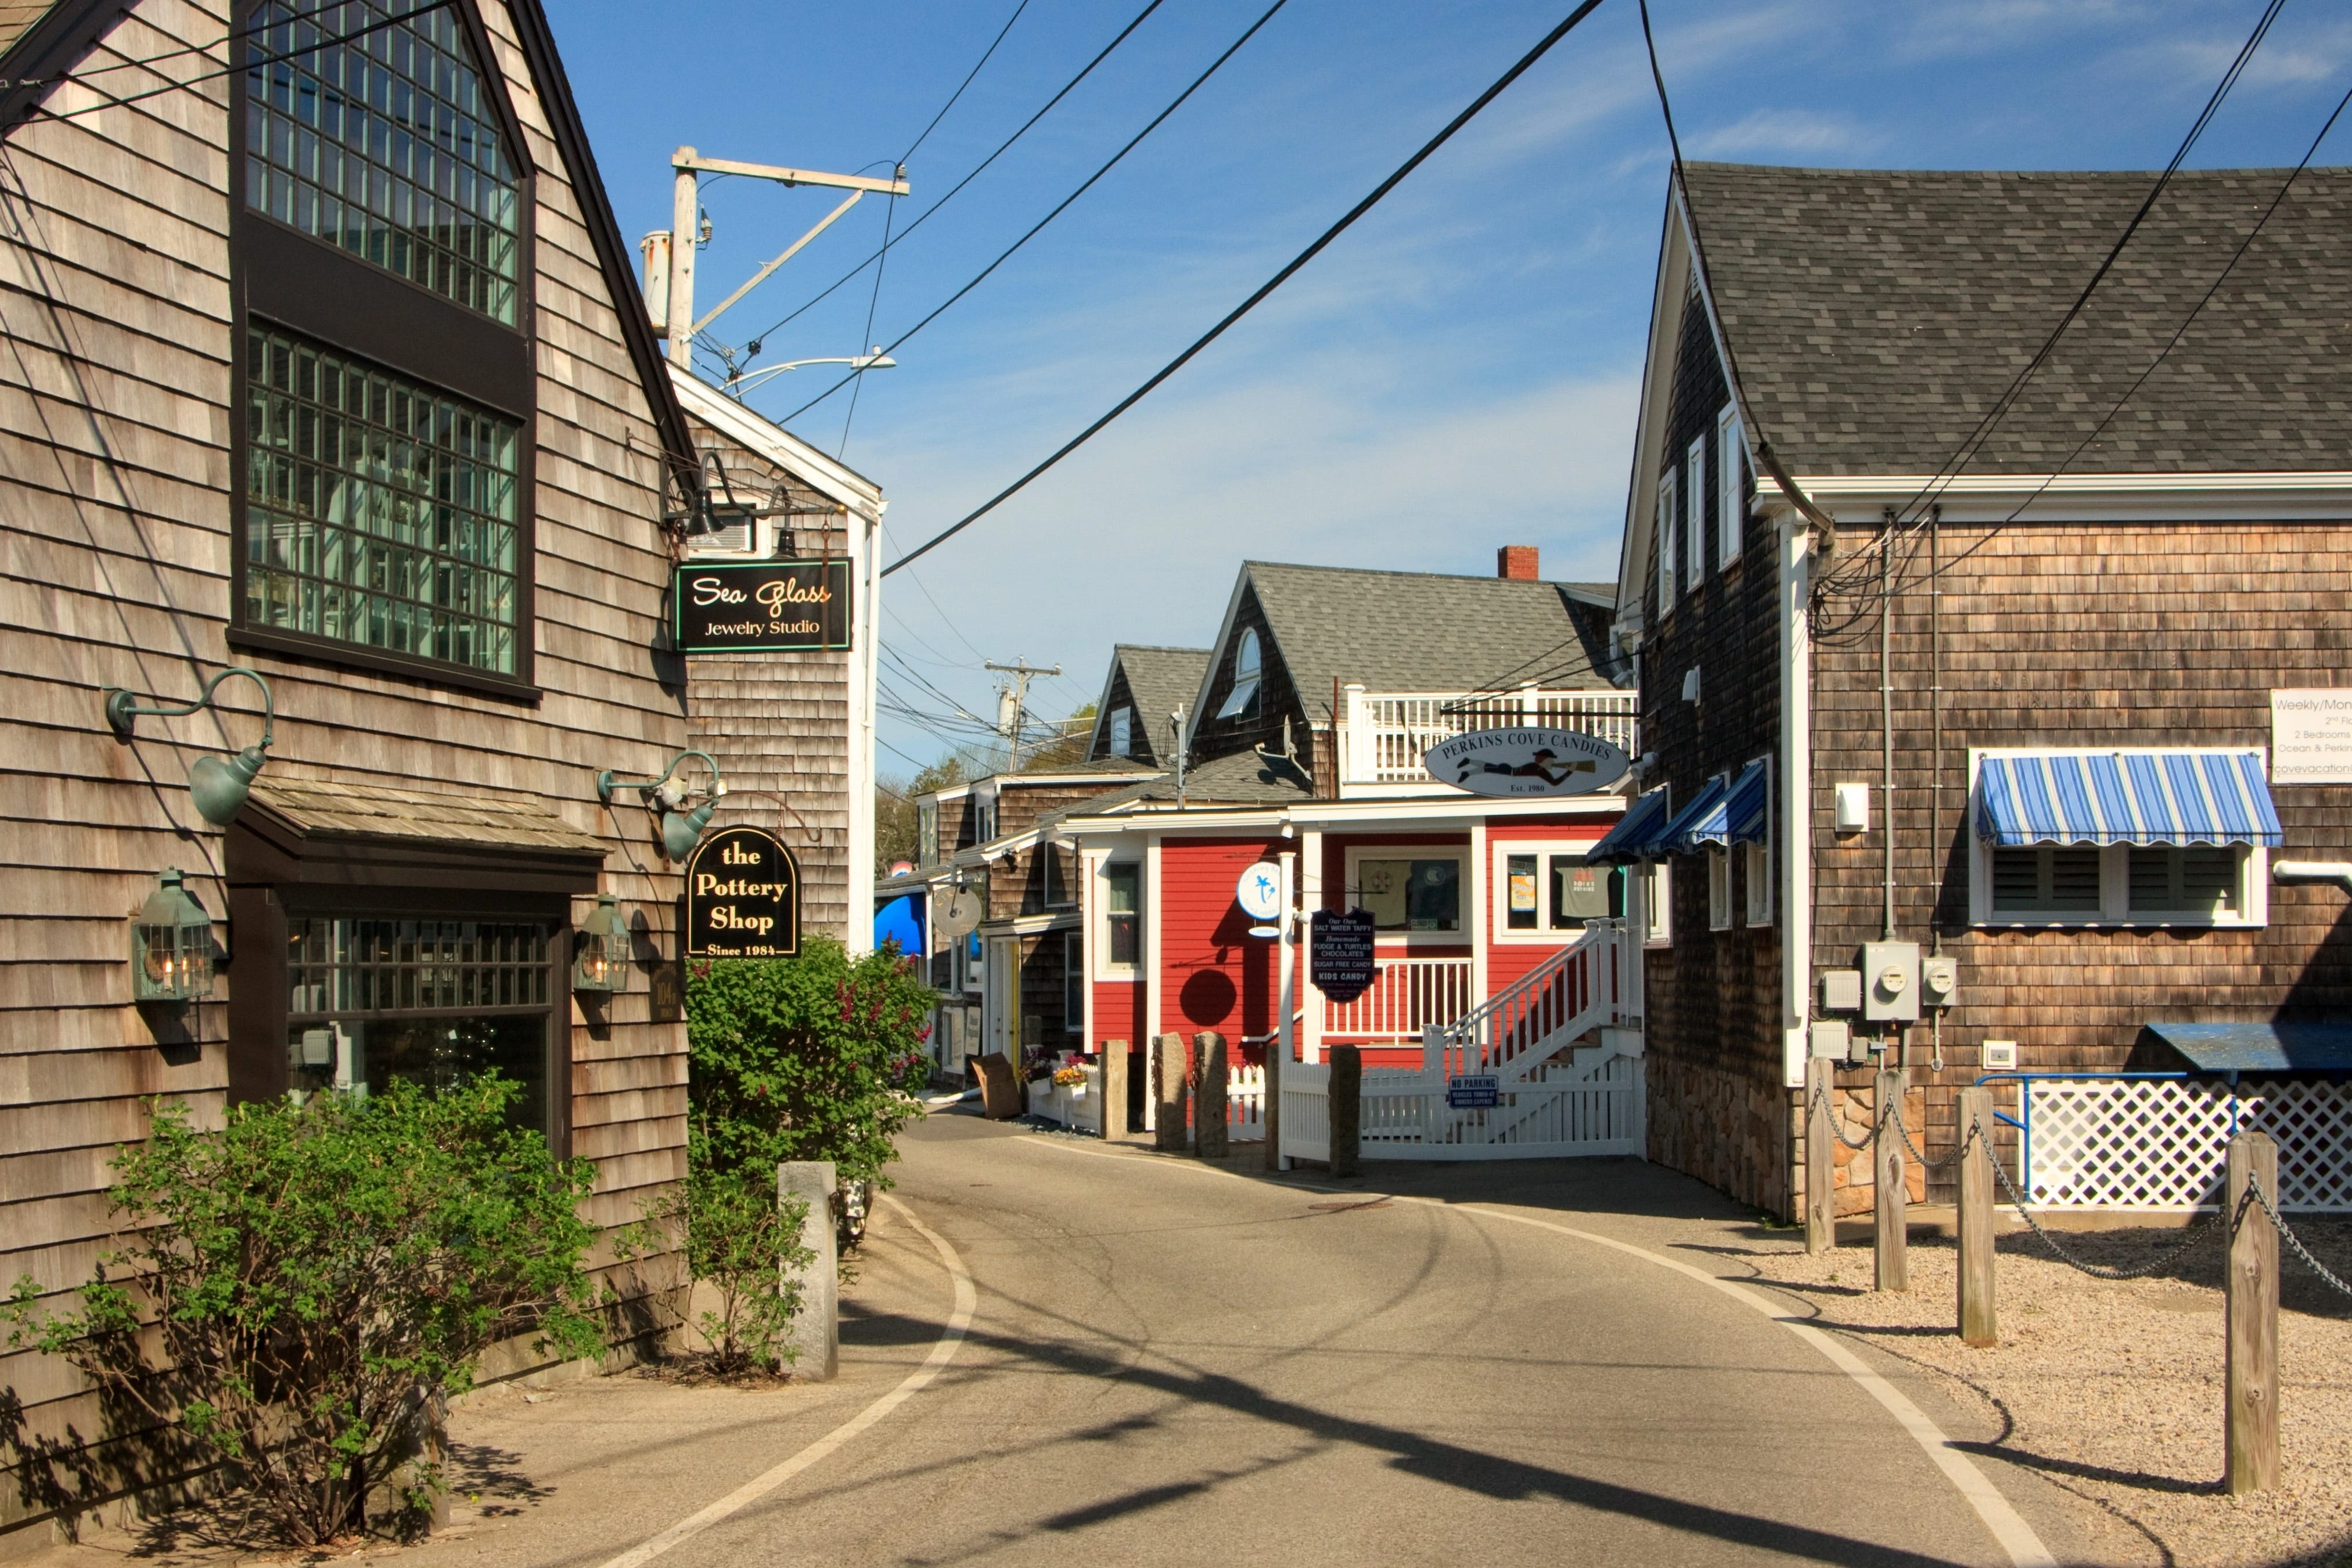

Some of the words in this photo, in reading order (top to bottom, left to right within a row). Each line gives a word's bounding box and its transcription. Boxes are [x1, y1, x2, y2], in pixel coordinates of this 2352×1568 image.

[693, 577, 747, 606] Sea
[756, 577, 832, 618] Glass
[705, 621, 765, 637] Jewelry
[769, 620, 819, 634] Studio
[1443, 735, 1502, 759] PERKINS
[1508, 733, 1545, 746] COVE
[1551, 734, 1612, 760] CANDIES
[2274, 764, 2352, 773] covevacation
[722, 841, 761, 864] the
[697, 873, 788, 902] Pottery
[710, 906, 774, 935] Shop
[707, 944, 741, 955] Since
[745, 945, 775, 955] 1984
[657, 982, 672, 1005] 104
[1452, 1080, 1461, 1088] NO
[1465, 1079, 1495, 1088] PARKING
